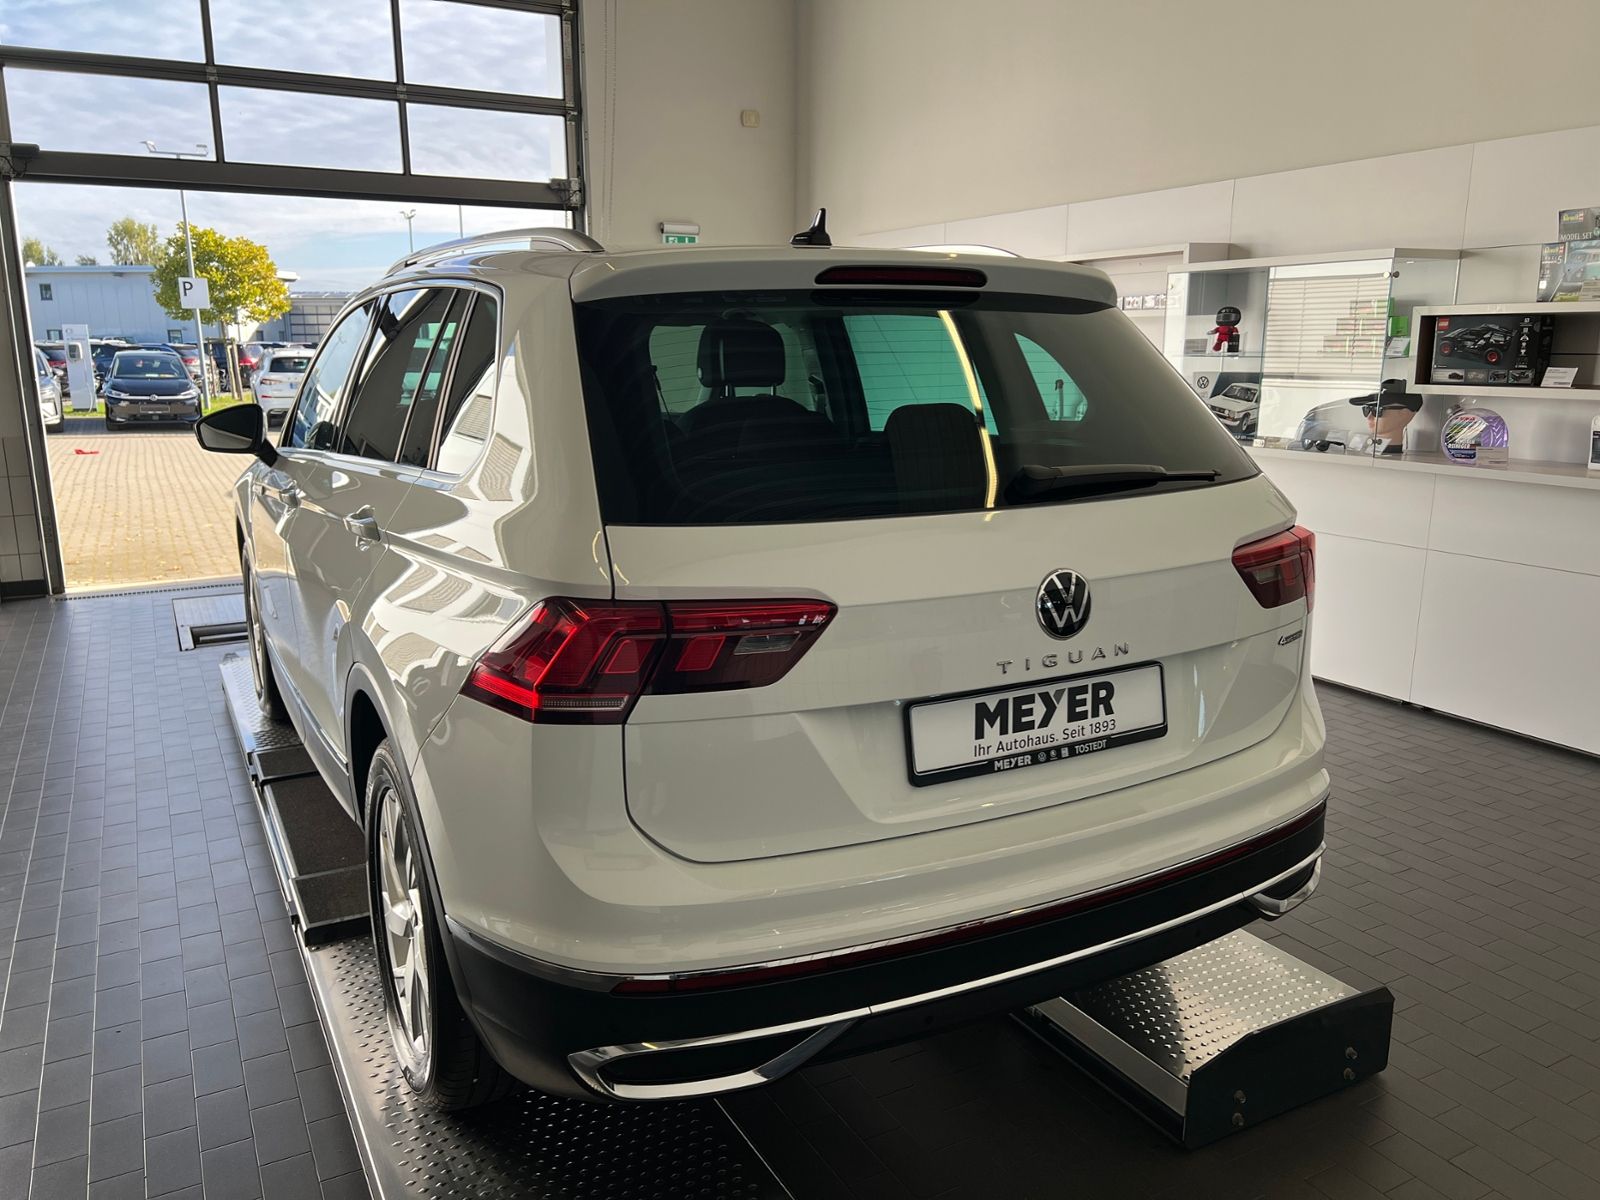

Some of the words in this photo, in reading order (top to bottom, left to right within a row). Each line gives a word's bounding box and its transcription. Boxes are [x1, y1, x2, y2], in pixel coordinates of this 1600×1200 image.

[1560, 233, 1580, 241] MODEL
[1582, 231, 1593, 240] SET
[183, 281, 193, 296] P
[996, 642, 1129, 675] TIGUAN
[974, 680, 1115, 741] MEYER
[974, 744, 992, 757] Ihr
[996, 733, 1059, 753] Autohaus.
[1062, 725, 1086, 740] Seit
[1089, 719, 1117, 735] 1893
[993, 754, 1032, 771] MEYER
[1074, 739, 1108, 754] TOSTEDT
